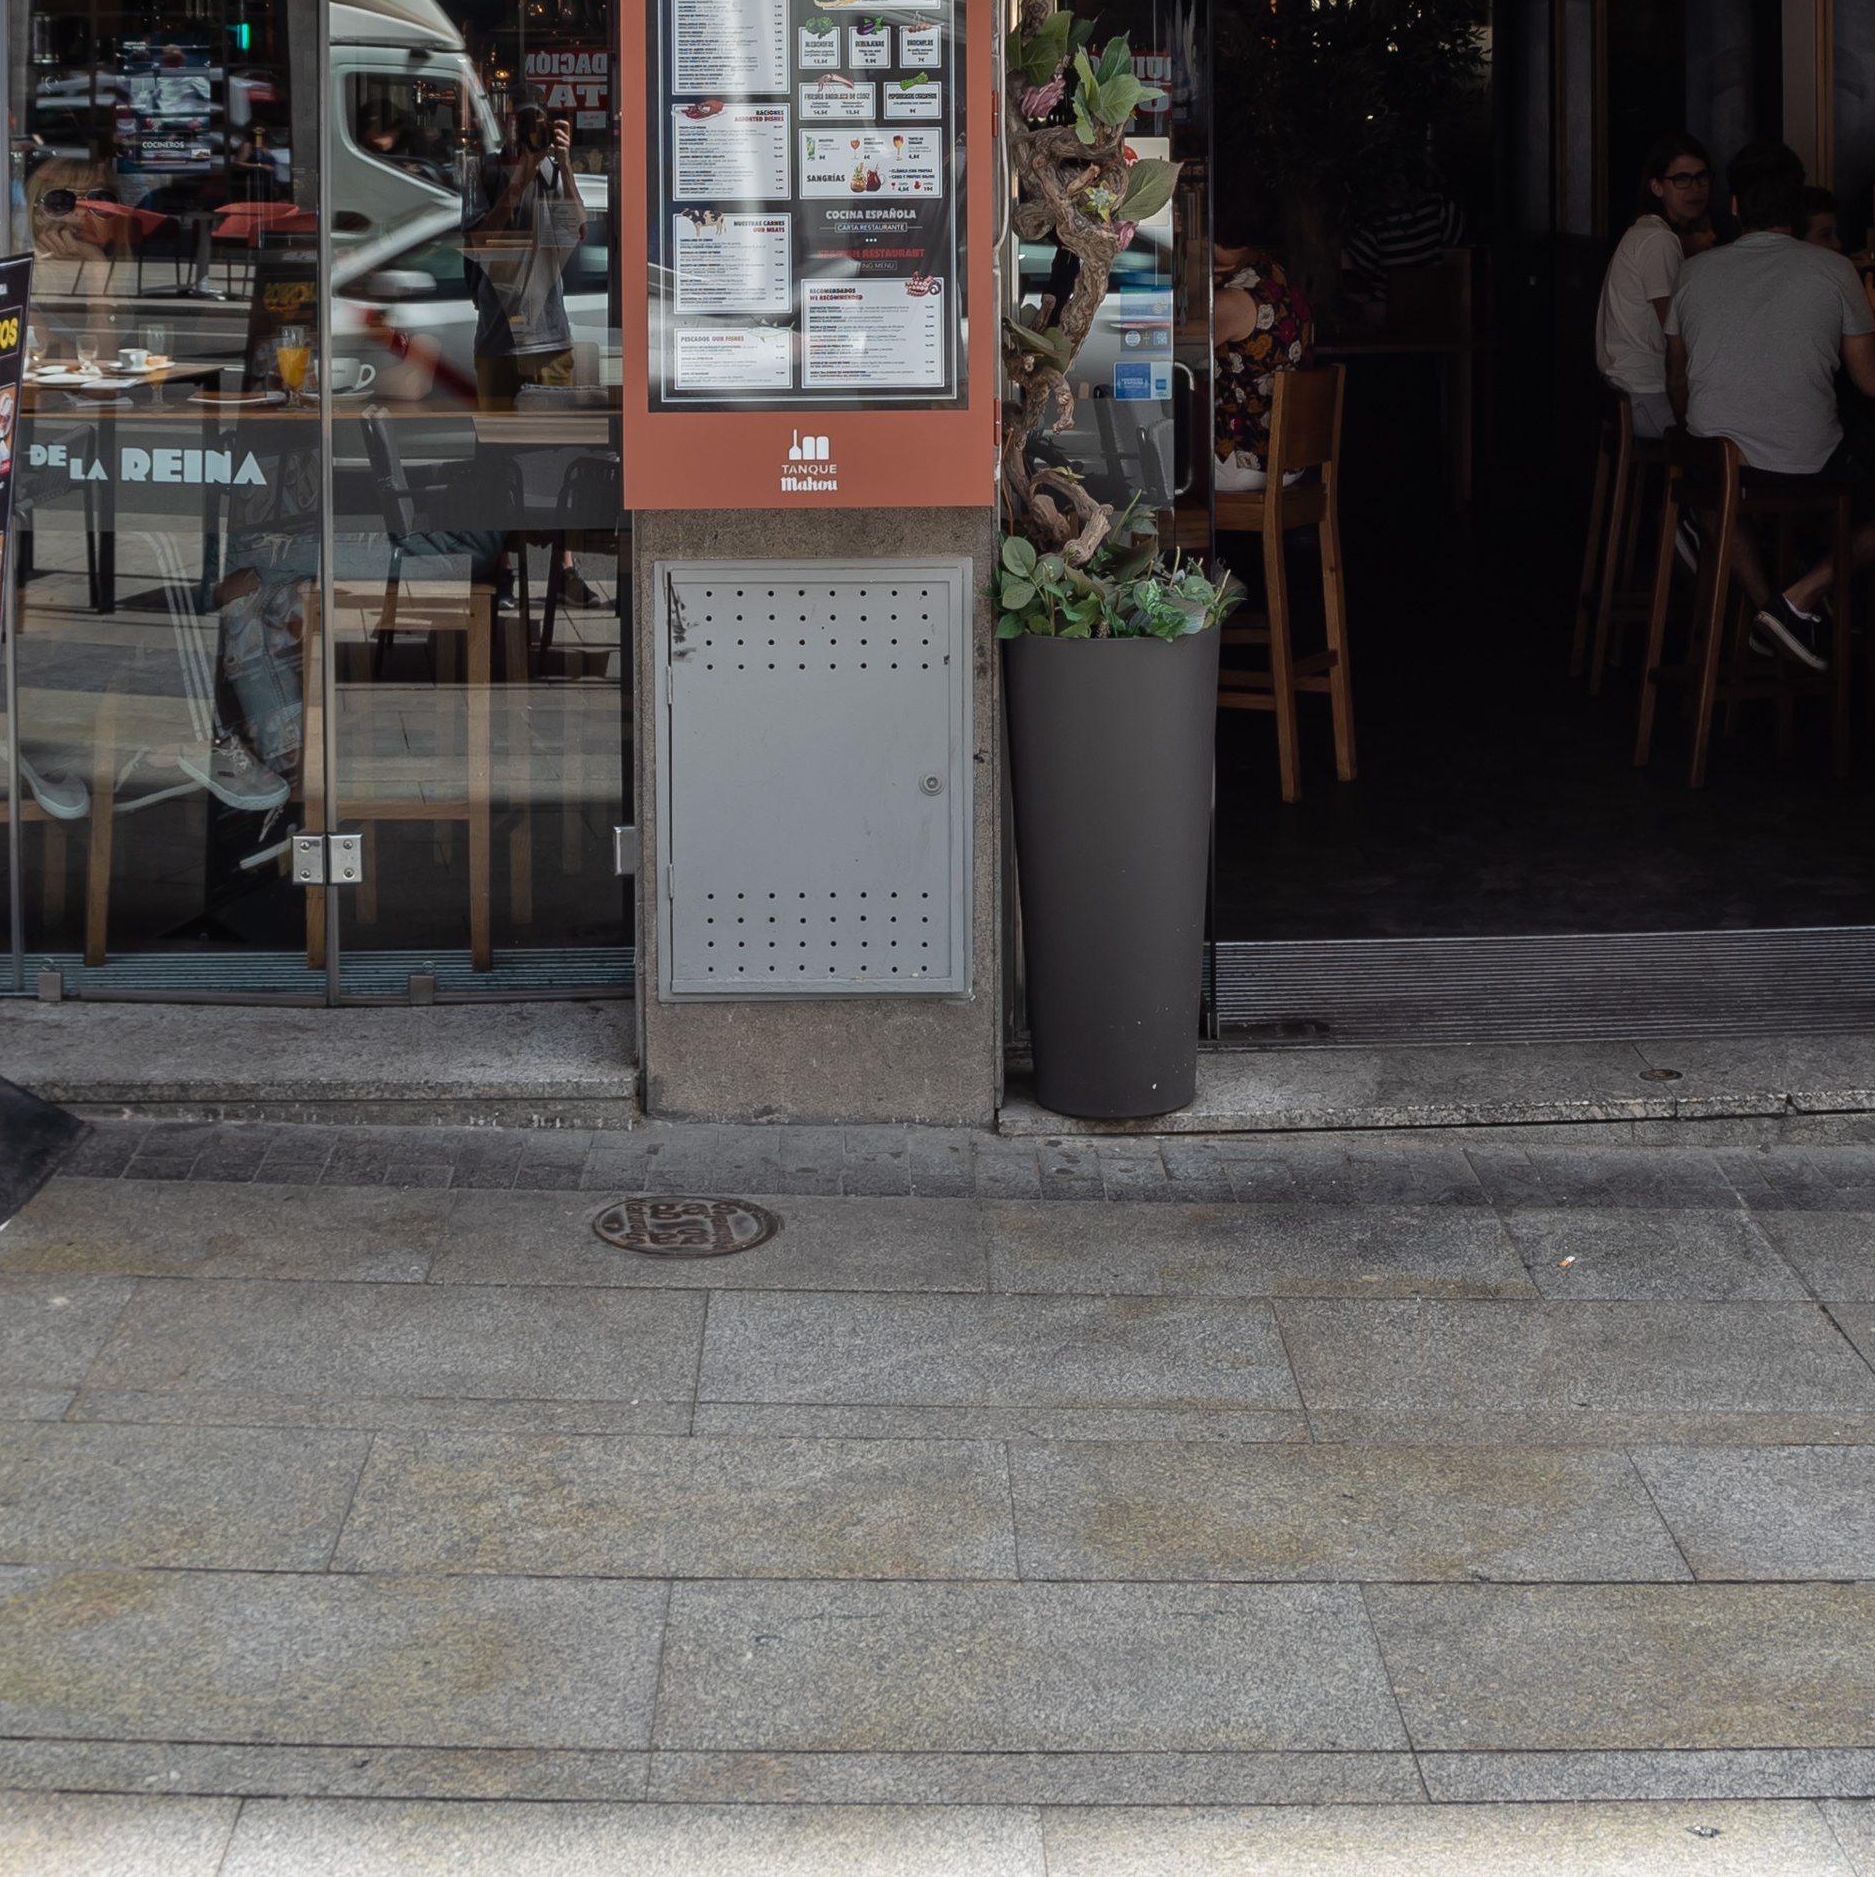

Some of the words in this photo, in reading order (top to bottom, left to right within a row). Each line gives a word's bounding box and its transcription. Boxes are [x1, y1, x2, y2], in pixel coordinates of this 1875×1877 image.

[142, 141, 185, 149] COCINEROS
[806, 173, 845, 183] SANGRÍAS
[826, 210, 864, 220] COCINA
[865, 208, 917, 219] ESPAÑOLA
[862, 248, 925, 258] RESTAURANT
[874, 261, 895, 269] MENU
[29, 443, 67, 467] DE
[69, 456, 109, 480] LA
[121, 446, 268, 485] REINA
[781, 464, 837, 475] TANQUE
[780, 477, 838, 492] Mahou
[649, 1202, 738, 1221] gas
